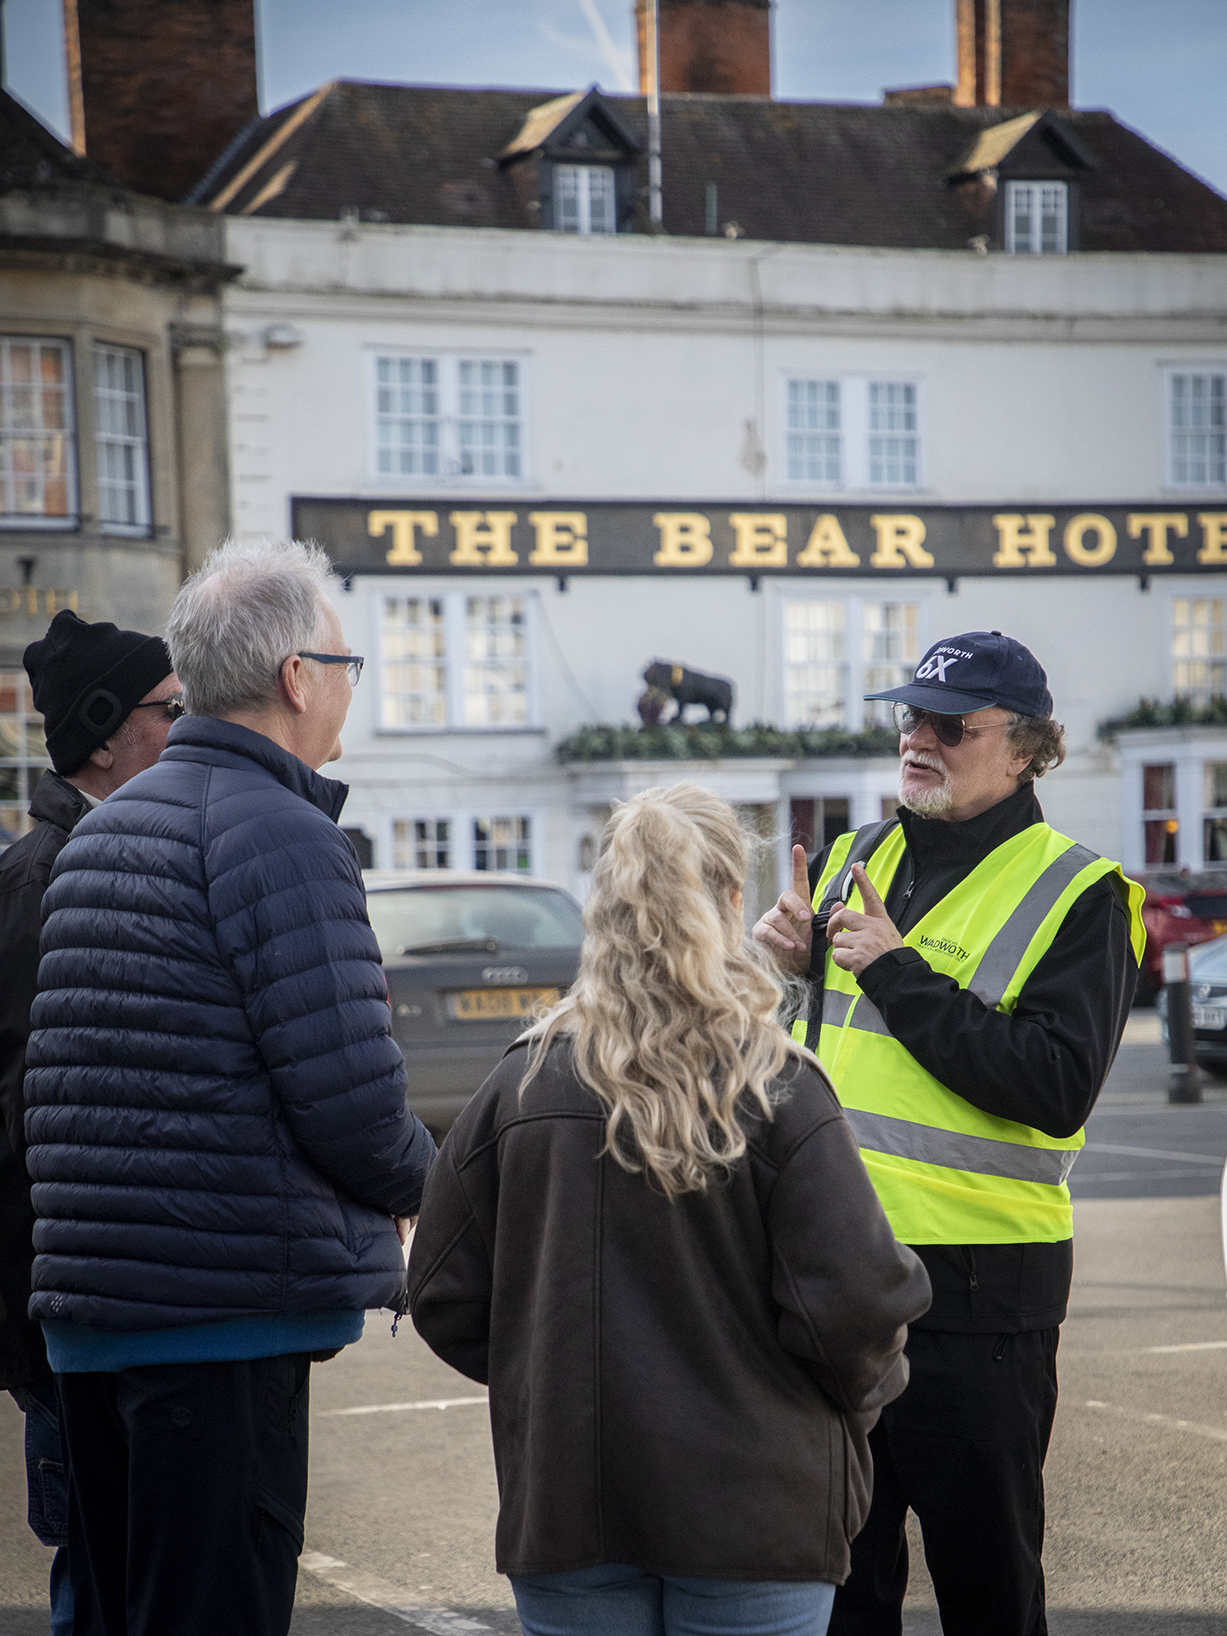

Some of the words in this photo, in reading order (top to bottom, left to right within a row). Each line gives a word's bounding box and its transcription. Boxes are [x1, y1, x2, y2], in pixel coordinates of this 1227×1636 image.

[367, 510, 589, 567] THE
[652, 511, 935, 569] BEAR
[916, 655, 959, 683] 6X
